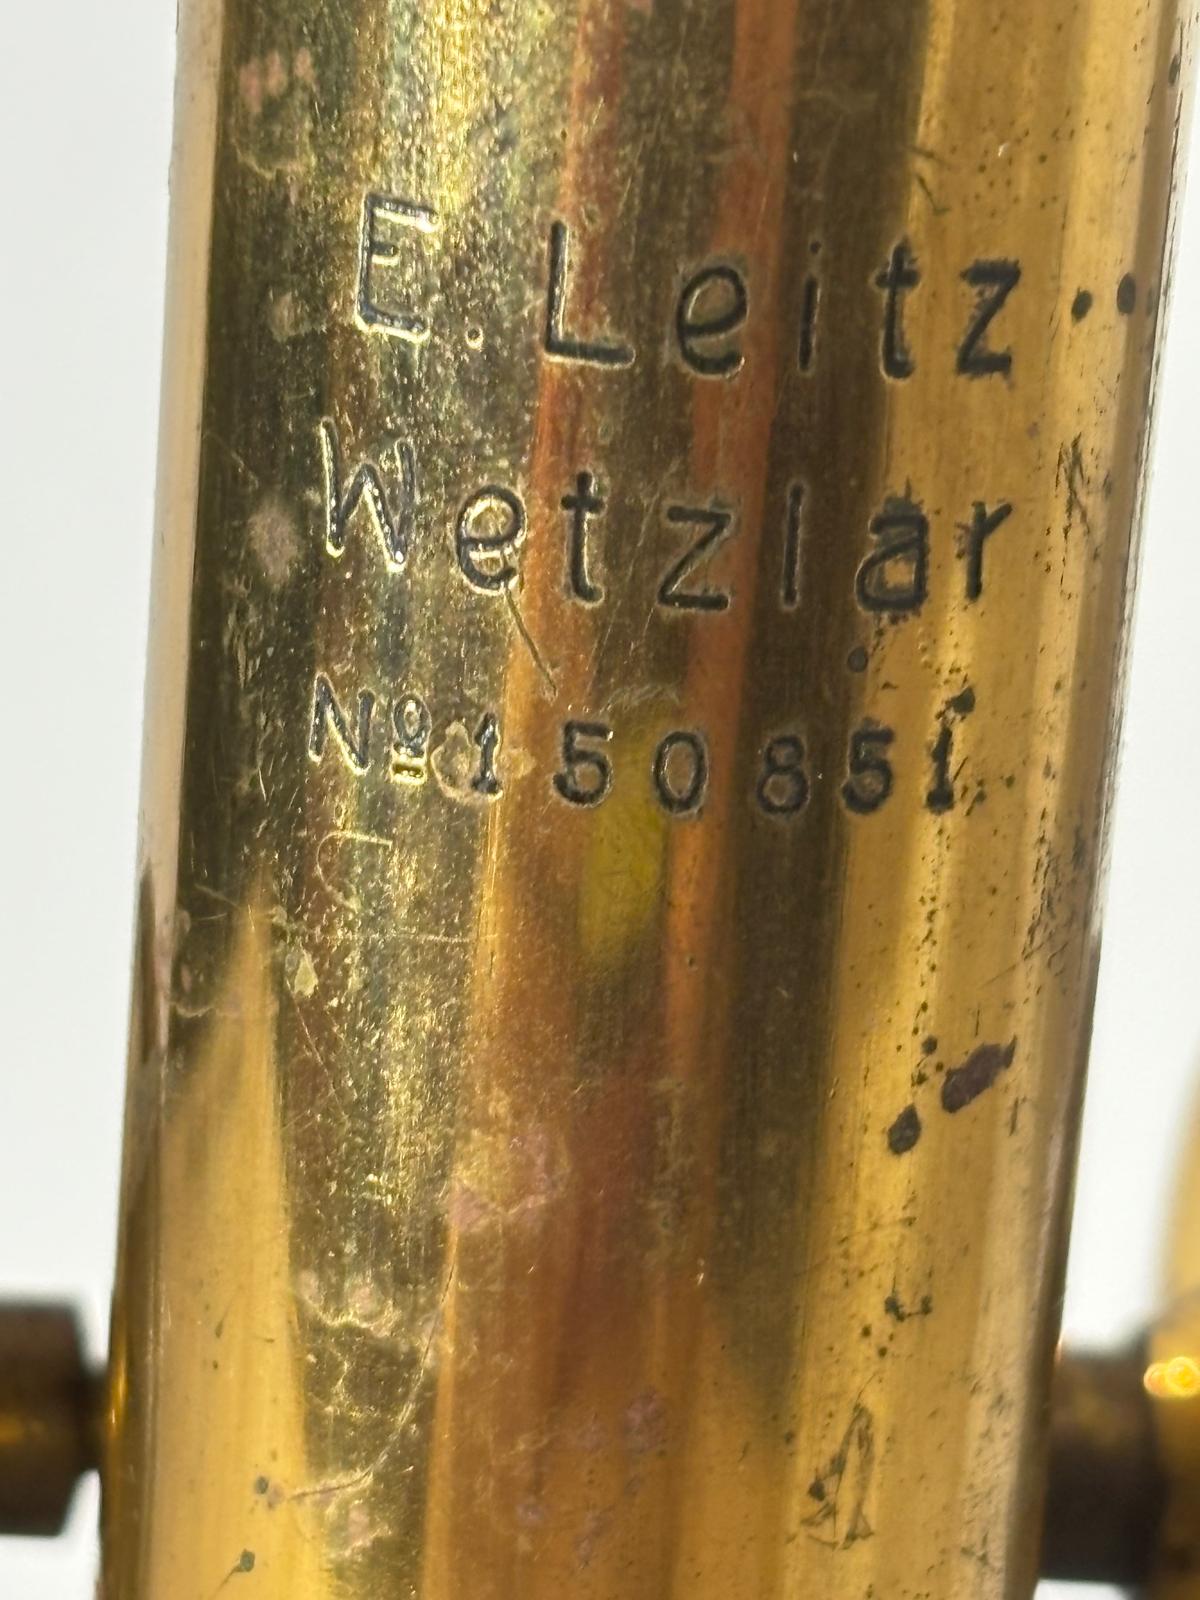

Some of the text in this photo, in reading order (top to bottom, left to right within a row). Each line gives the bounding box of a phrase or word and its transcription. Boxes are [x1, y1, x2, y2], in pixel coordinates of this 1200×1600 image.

[542, 221, 1022, 380] Leitz
[318, 416, 1013, 614] Wetzlar
[468, 708, 955, 816] 150851
